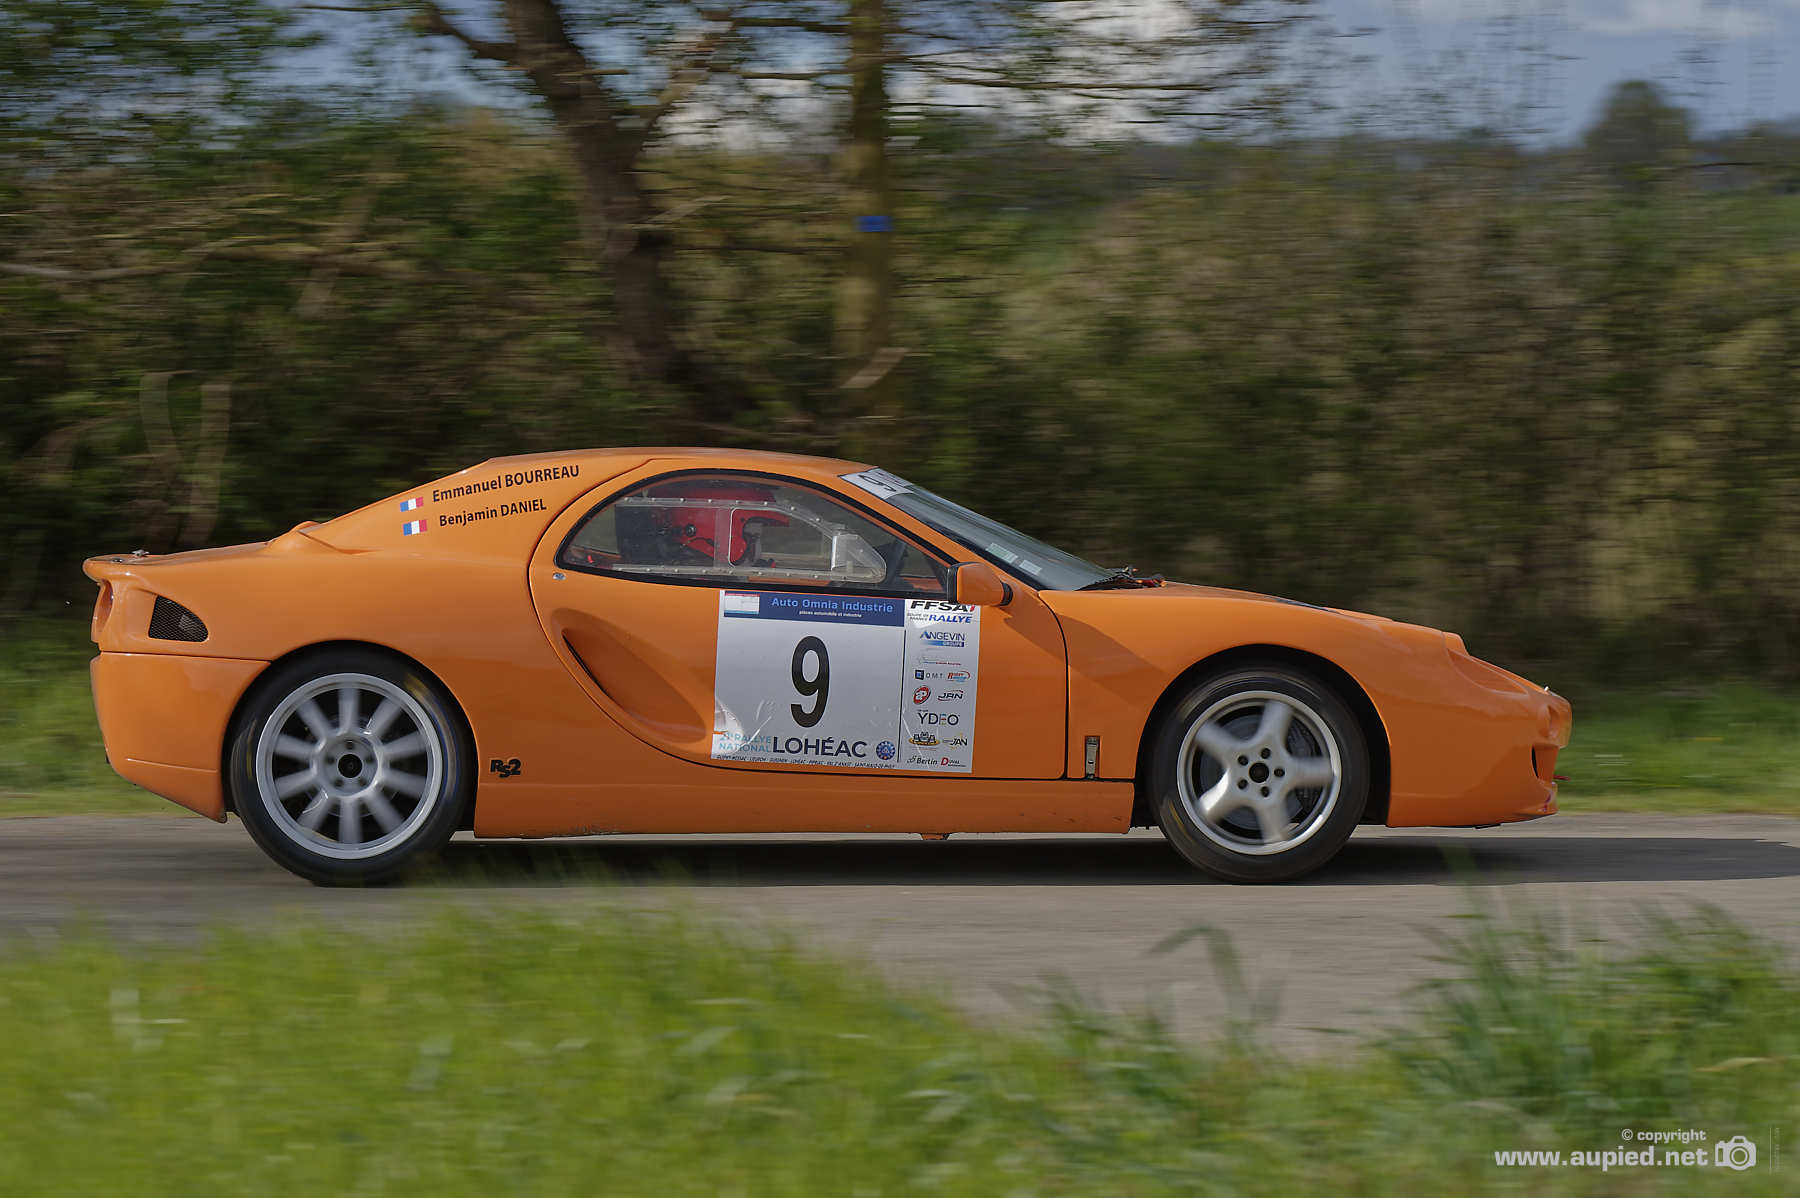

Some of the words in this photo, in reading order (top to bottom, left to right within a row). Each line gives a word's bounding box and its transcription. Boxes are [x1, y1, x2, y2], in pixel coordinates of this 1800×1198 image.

[432, 476, 502, 502] Emmanuel
[505, 465, 580, 487] BOURREAU
[439, 507, 498, 526] Benjamin
[500, 498, 547, 517] DANIEL
[771, 597, 799, 607] Auto
[802, 599, 838, 609] Omnia
[842, 600, 894, 613] Industrie
[910, 600, 969, 612] FFSA
[928, 614, 973, 623] RALLYE
[920, 630, 965, 641] ANGEVIN
[790, 635, 830, 728] 9
[918, 712, 959, 726] YDEO
[735, 733, 772, 744] RALLYE
[719, 742, 772, 753] NATIONAL
[772, 736, 868, 758] LOHÉAC
[490, 758, 522, 778] RS2
[916, 756, 938, 766] Bertin
